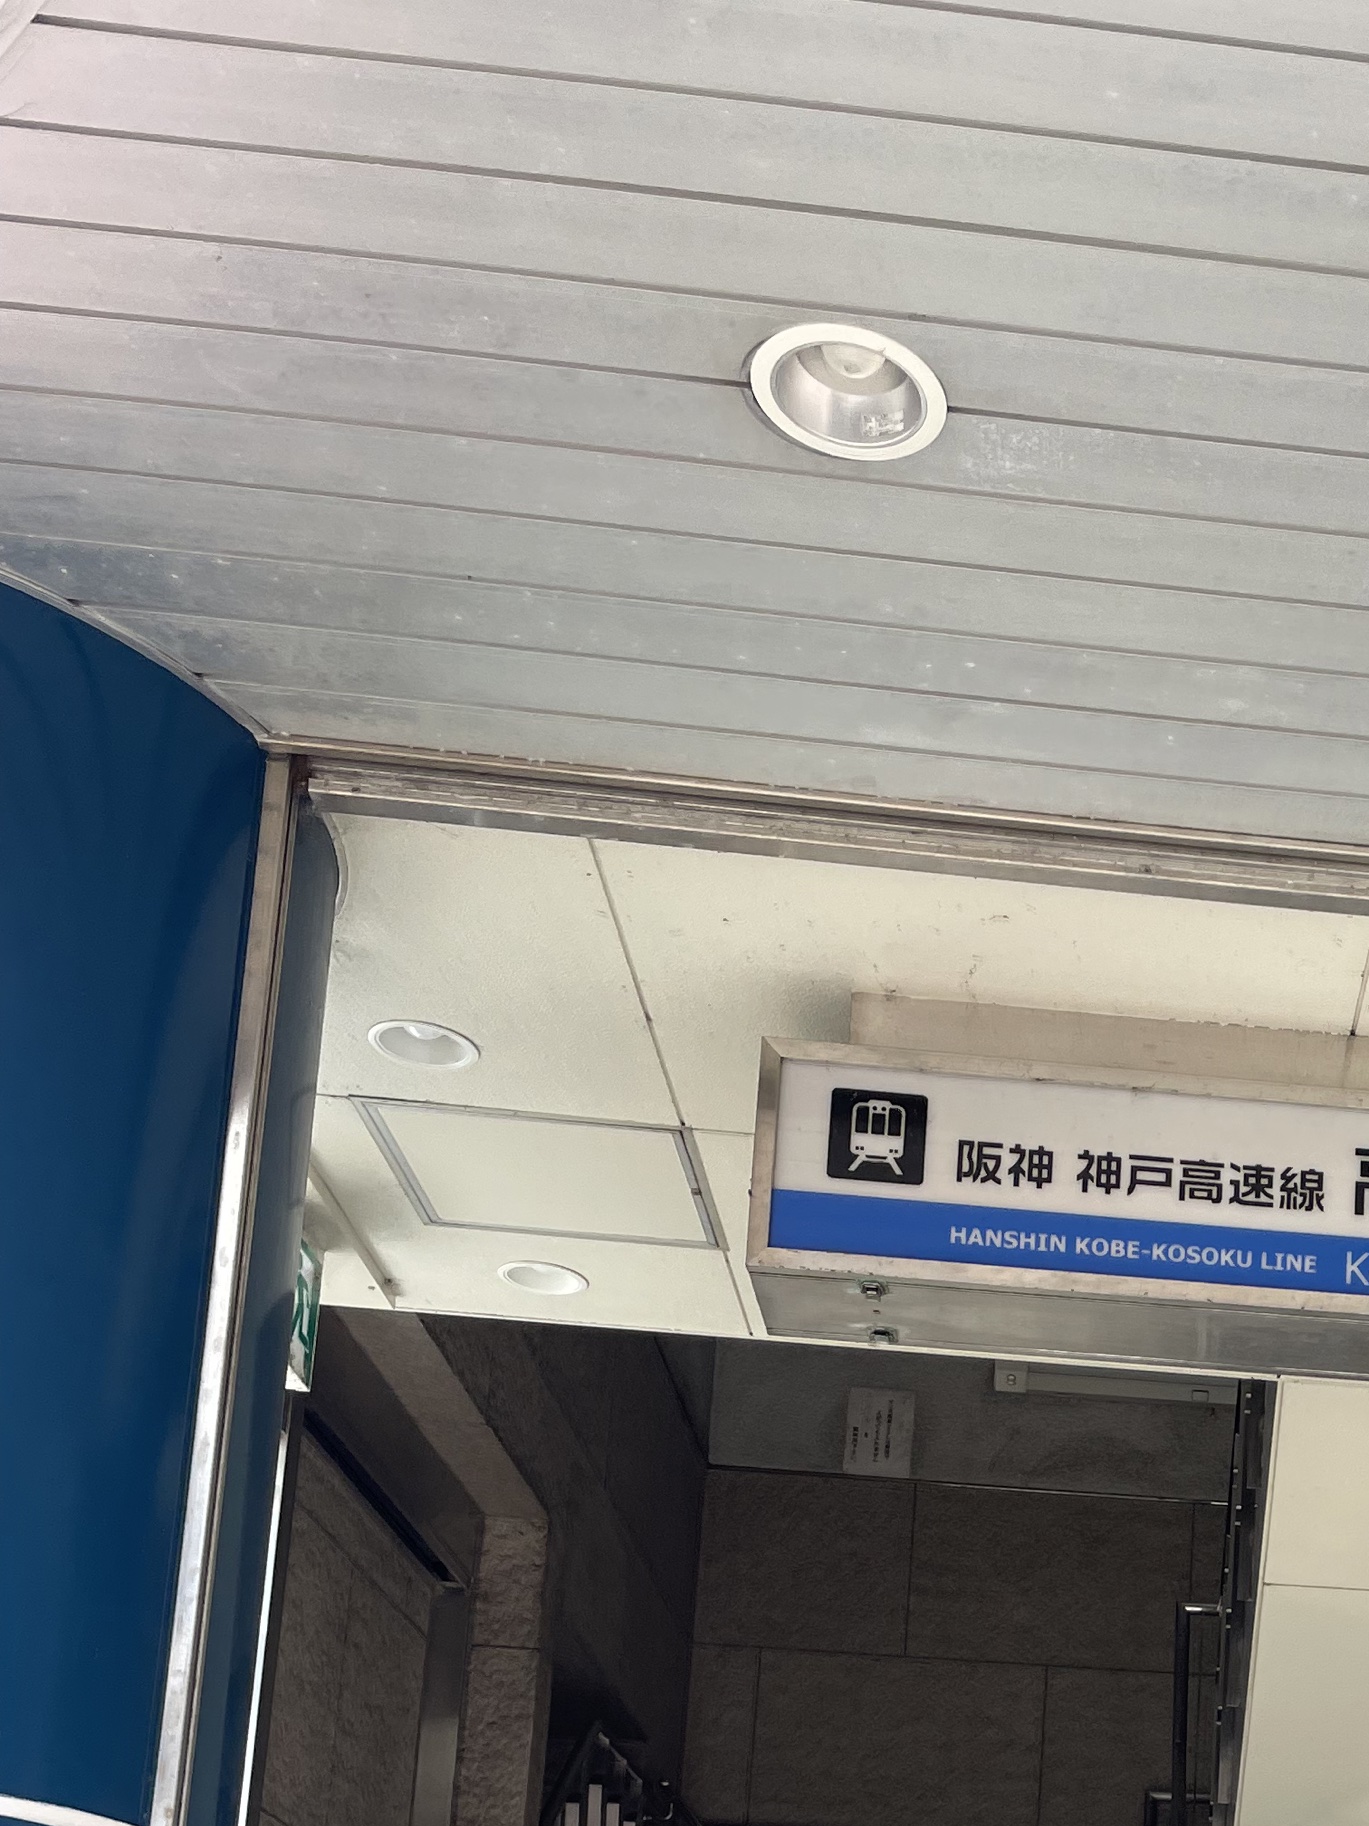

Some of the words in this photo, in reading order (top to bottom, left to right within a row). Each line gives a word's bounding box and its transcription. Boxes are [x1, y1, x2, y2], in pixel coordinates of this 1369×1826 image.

[956, 1139, 1054, 1190] 阪神
[1076, 1149, 1325, 1212] 神戸高速線
[950, 1226, 1066, 1253] HANSHIN
[1075, 1237, 1252, 1268] KOBE-KOSOKU
[1261, 1251, 1317, 1273] LINE
